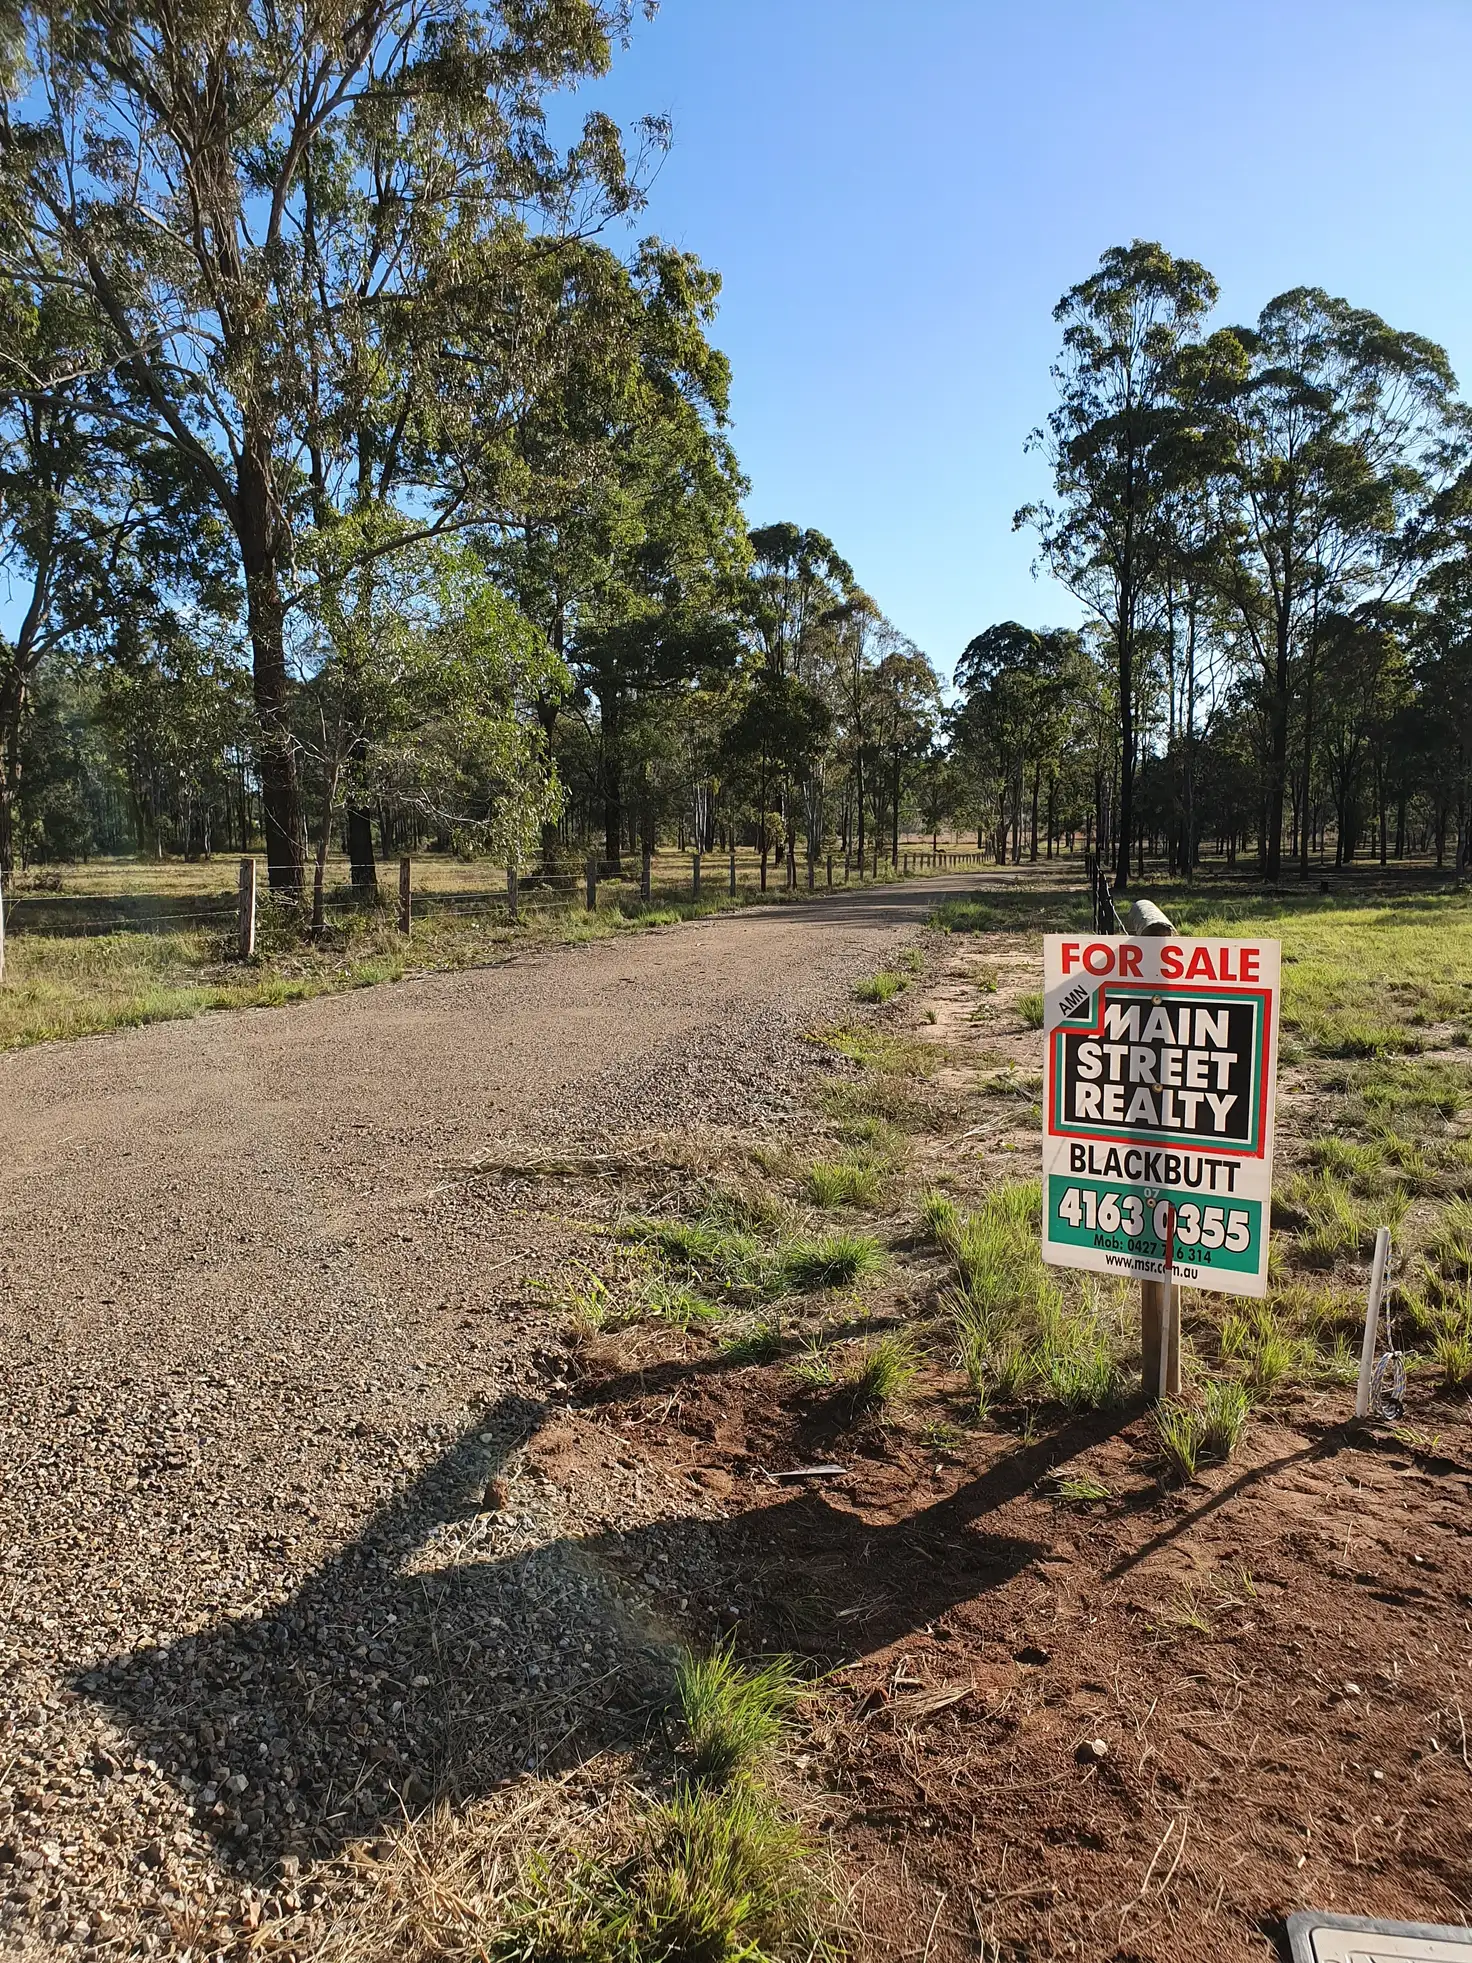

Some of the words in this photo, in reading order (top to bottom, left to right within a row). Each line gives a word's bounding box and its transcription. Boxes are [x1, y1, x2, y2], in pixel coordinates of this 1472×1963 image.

[1061, 943, 1144, 978] FOR
[1160, 946, 1260, 982] SALE
[1058, 985, 1088, 1016] AMN
[1088, 1004, 1230, 1048] MAIN
[1077, 1042, 1238, 1090] STREET
[1075, 1081, 1239, 1132] REALTY
[1070, 1143, 1241, 1192] BLACKBUTT
[1143, 1188, 1160, 1198] 07
[1058, 1187, 1145, 1237] 4163
[1152, 1199, 1251, 1253] 0355
[1093, 1234, 1123, 1250] Mob:
[1127, 1239, 1157, 1255] 0427
[1188, 1248, 1212, 1264] 314
